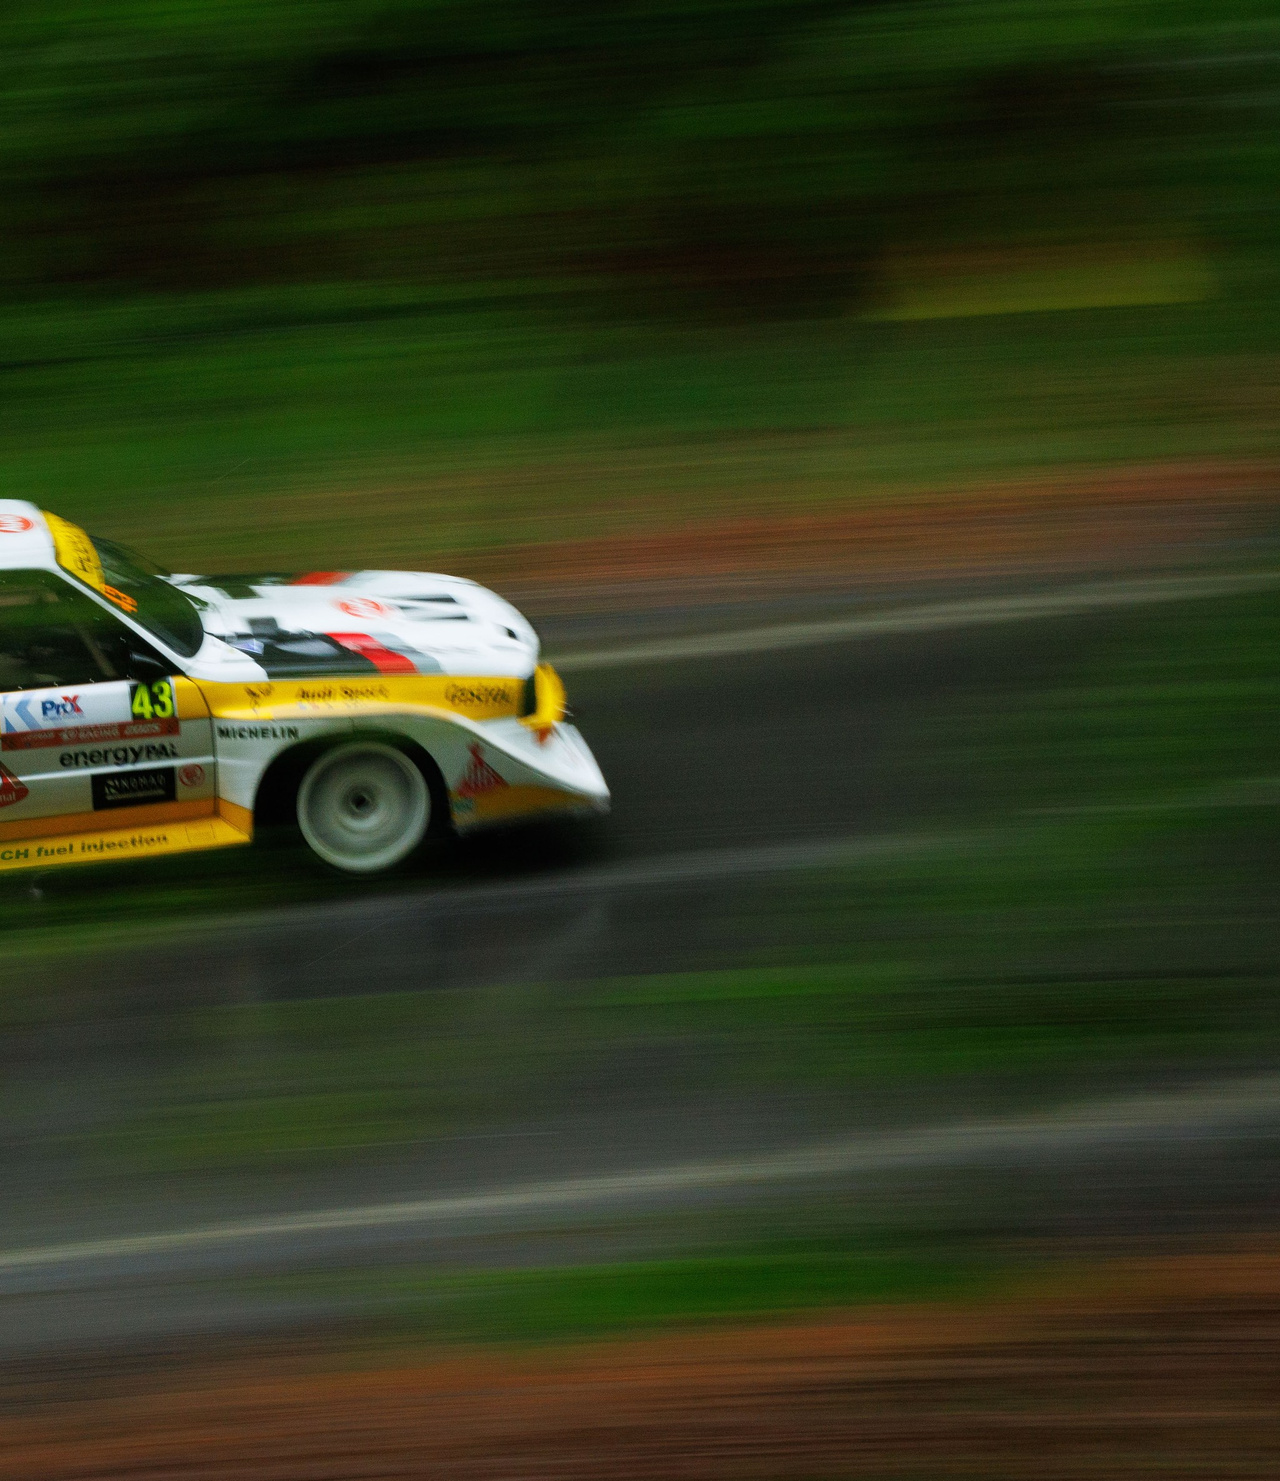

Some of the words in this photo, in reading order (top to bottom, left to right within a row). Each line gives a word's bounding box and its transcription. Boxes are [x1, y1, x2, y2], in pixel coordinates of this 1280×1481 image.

[41, 694, 85, 717] ProX
[131, 681, 174, 720] 43
[218, 726, 300, 740] MICHELIN
[36, 840, 74, 858] fuel
[80, 833, 169, 853] injection
